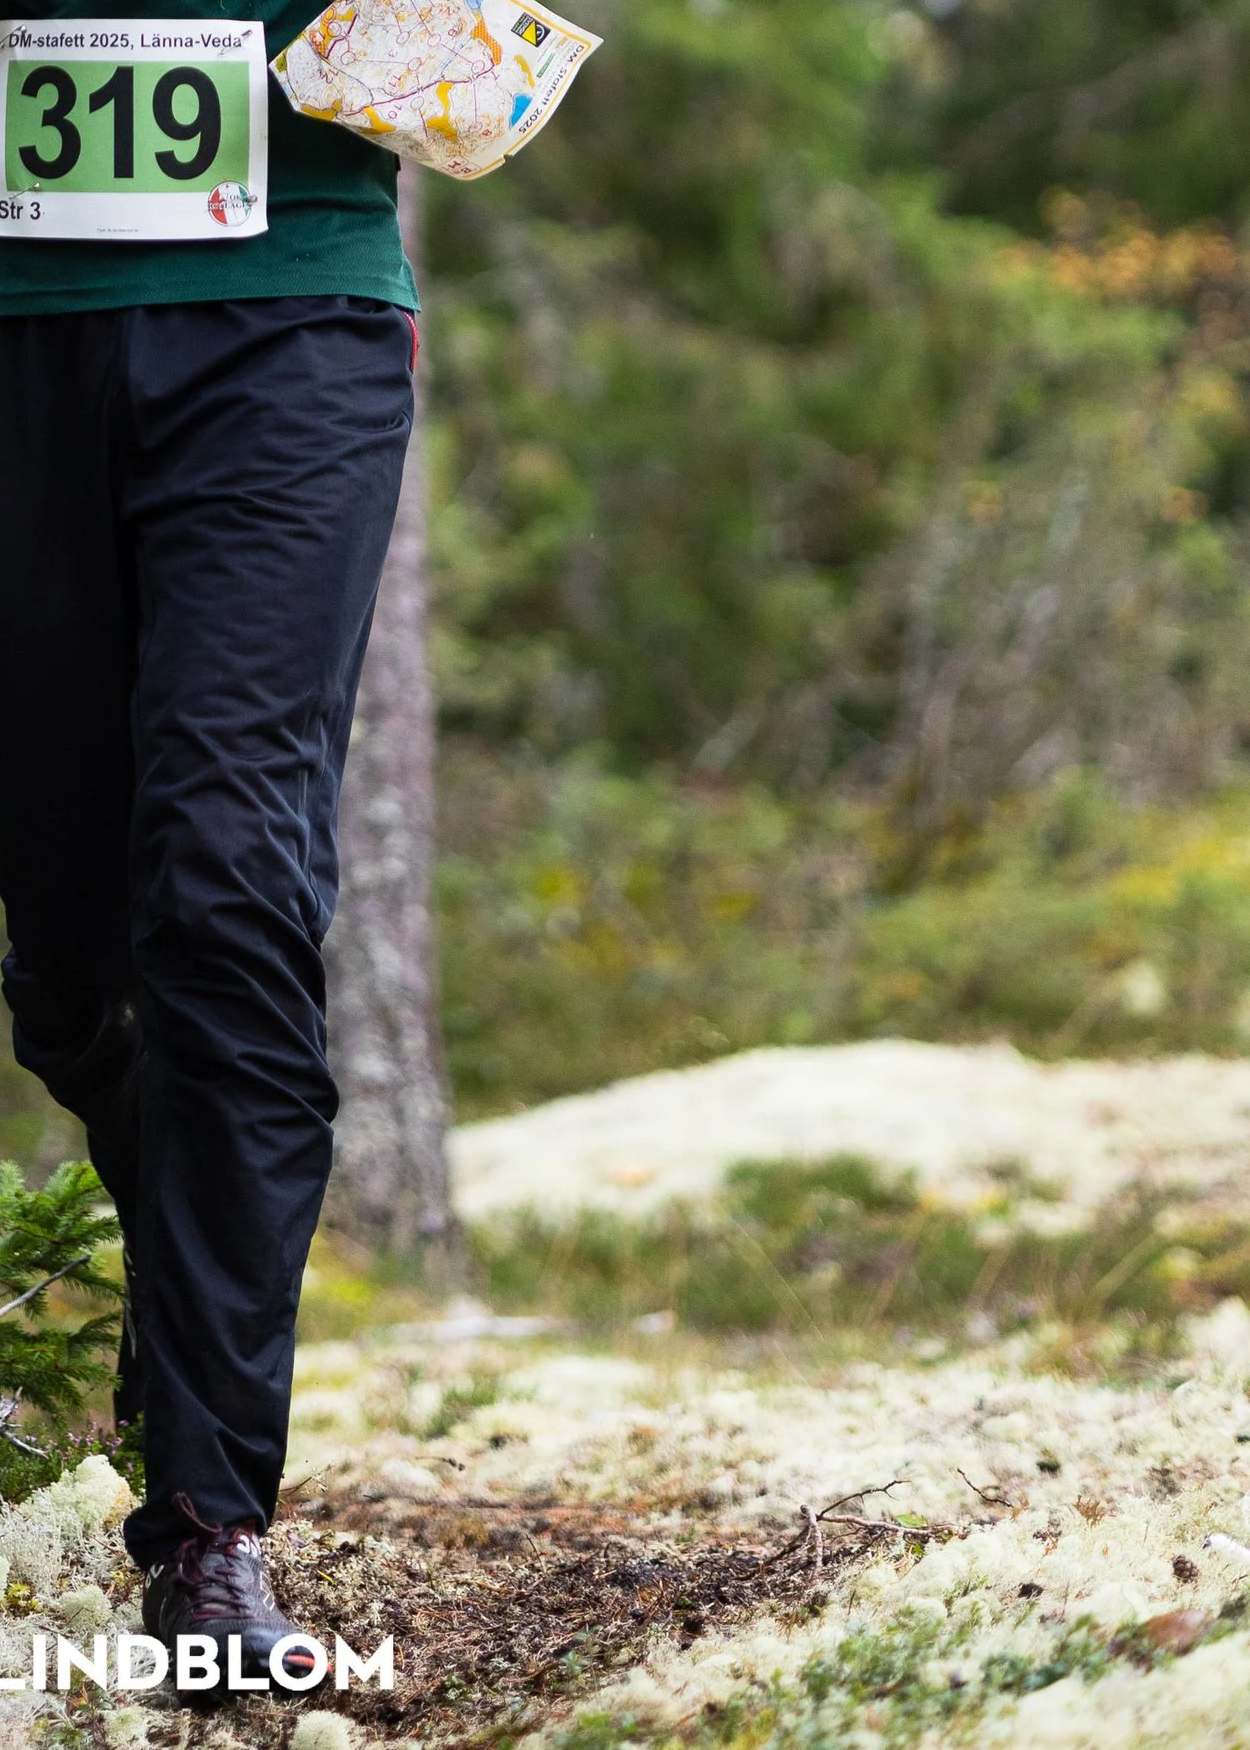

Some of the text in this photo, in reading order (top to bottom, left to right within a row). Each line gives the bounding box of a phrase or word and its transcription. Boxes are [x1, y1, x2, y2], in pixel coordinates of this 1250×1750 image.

[8, 33, 242, 50] DM-stafett 2025, Länna-Veda
[18, 64, 222, 181] 319
[518, 108, 543, 134] 2025
[29, 201, 41, 220] 3
